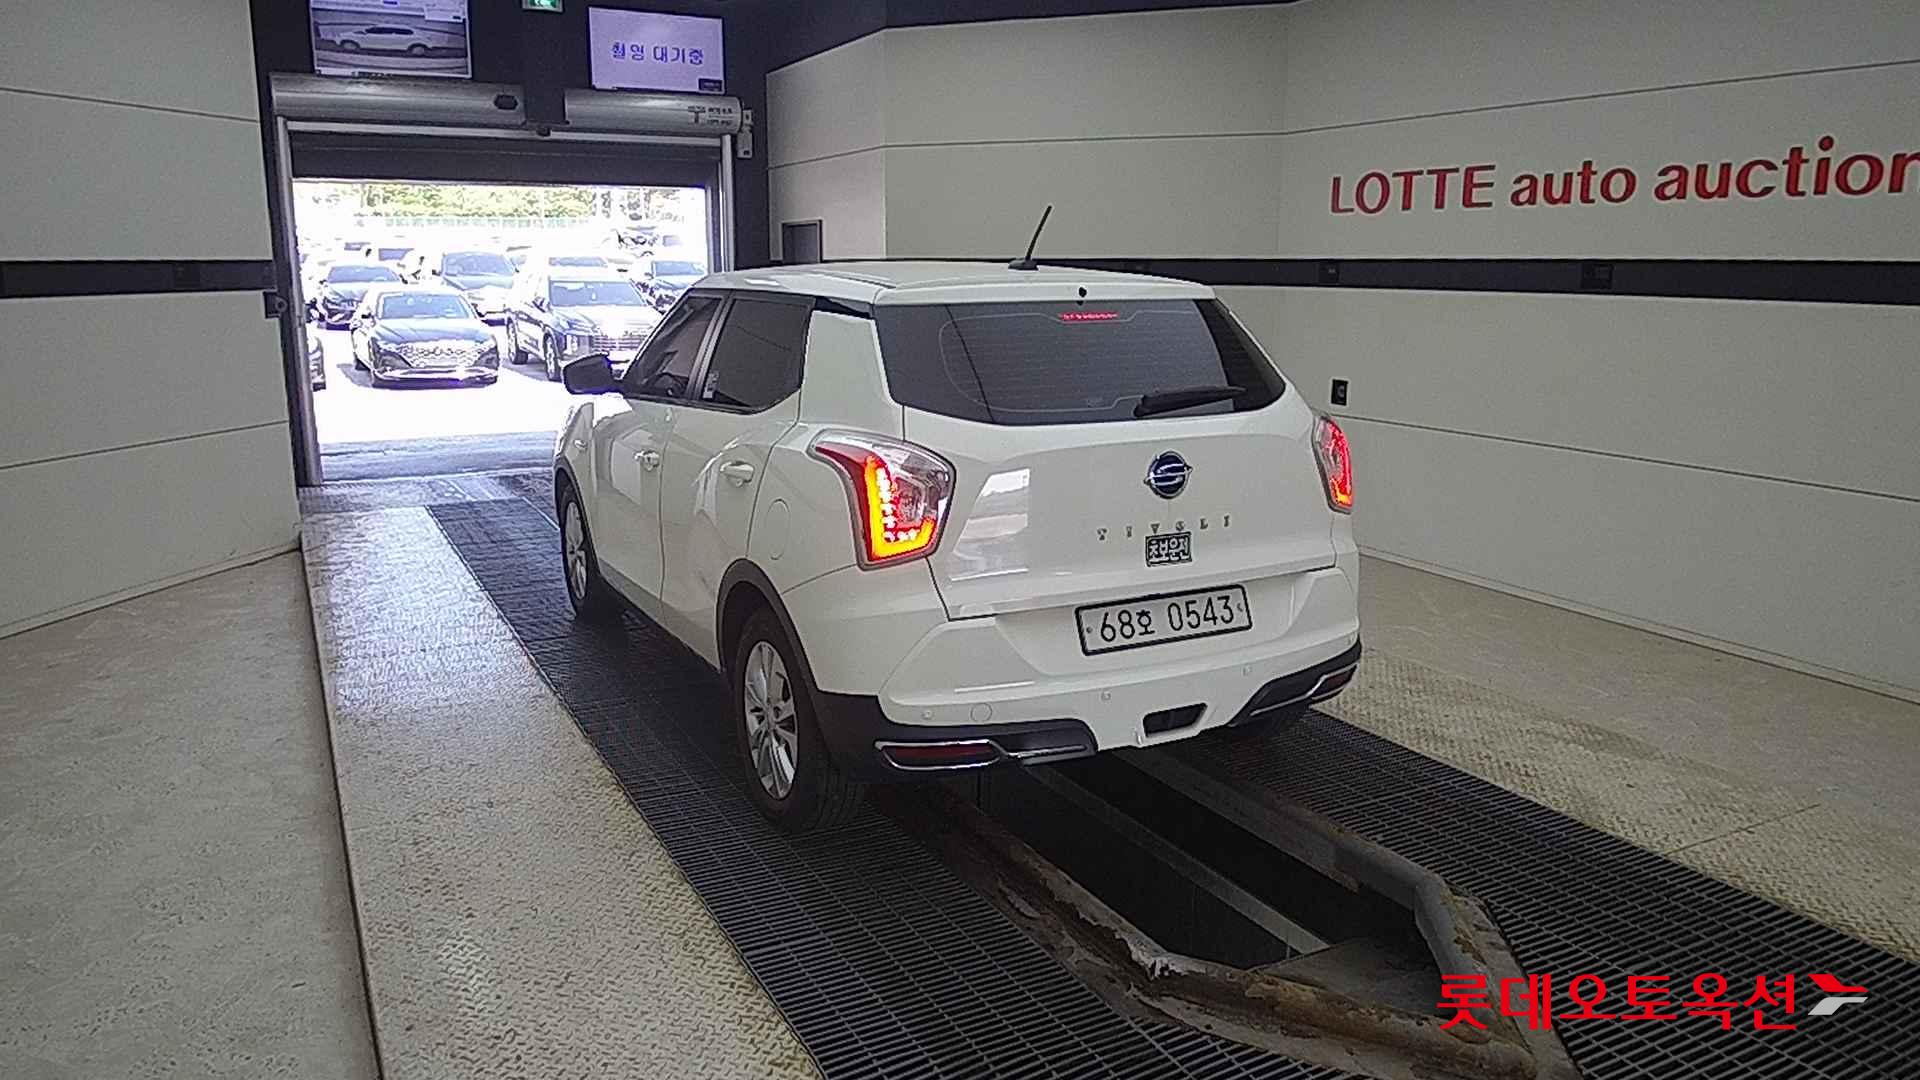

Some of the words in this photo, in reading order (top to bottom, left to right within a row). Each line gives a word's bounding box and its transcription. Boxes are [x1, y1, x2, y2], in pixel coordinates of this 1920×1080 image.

[1331, 165, 1497, 215] LOTTE
[1511, 160, 1636, 205] auto
[1096, 514, 1231, 541] TIVOLI
[1100, 609, 1156, 643] 68호
[1167, 595, 1235, 632] 0543
